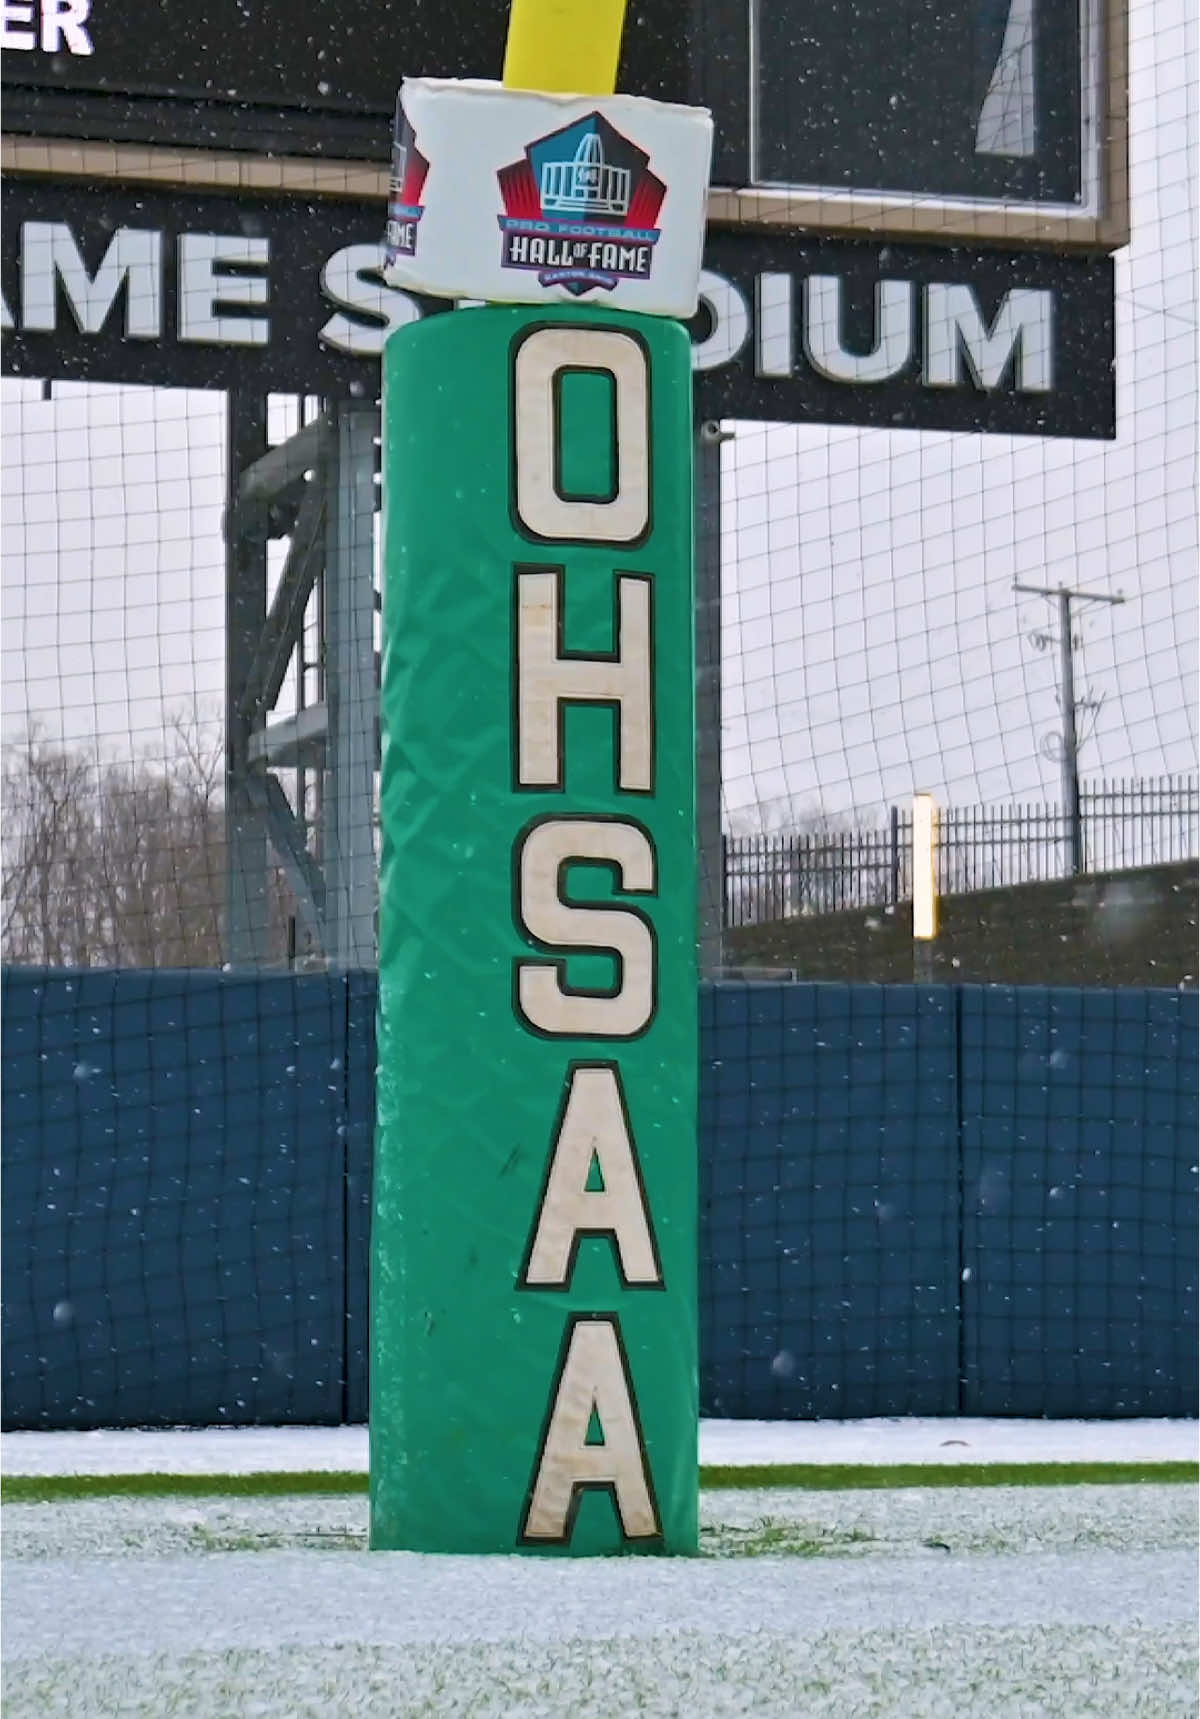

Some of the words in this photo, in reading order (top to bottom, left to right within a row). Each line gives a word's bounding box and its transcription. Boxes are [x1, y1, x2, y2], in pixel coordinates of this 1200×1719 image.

[510, 236, 573, 267] HALL
[572, 243, 588, 259] OF
[588, 242, 649, 273] FAME
[558, 226, 655, 240] FOOTBALL
[0, 221, 268, 344] ME
[511, 320, 667, 1547] OHSAA
